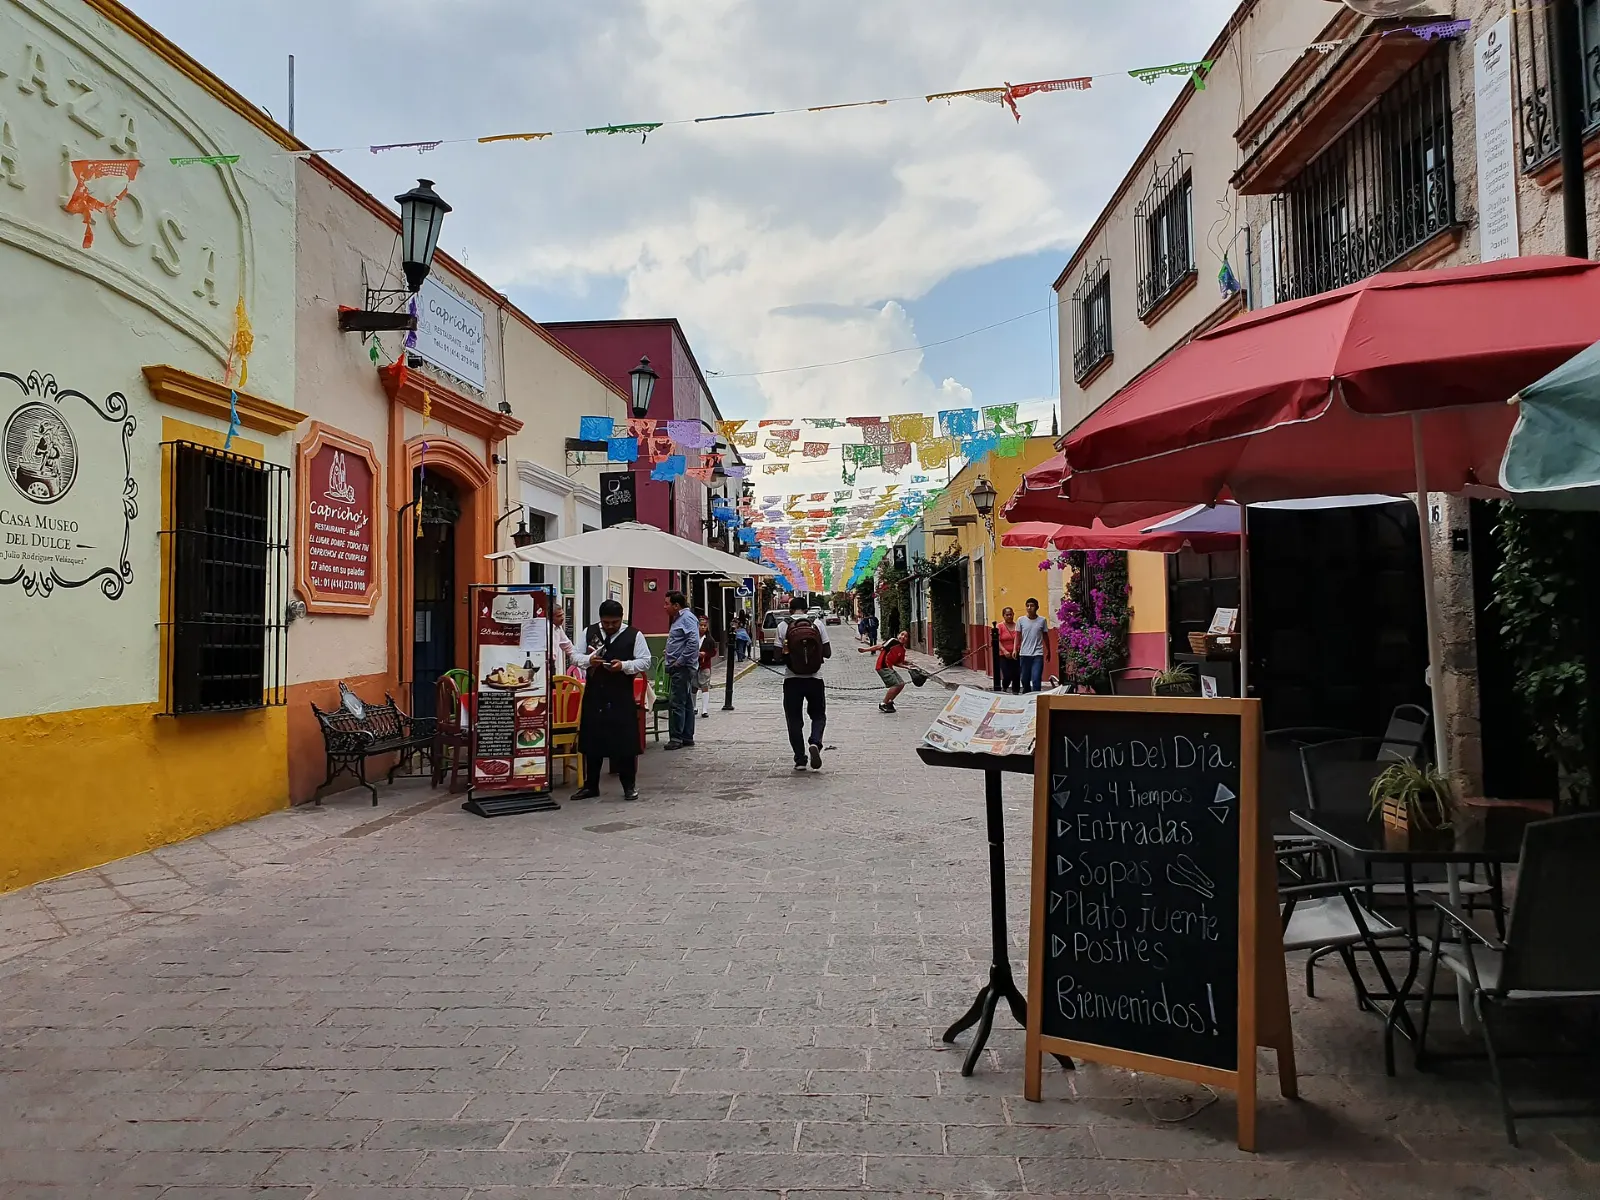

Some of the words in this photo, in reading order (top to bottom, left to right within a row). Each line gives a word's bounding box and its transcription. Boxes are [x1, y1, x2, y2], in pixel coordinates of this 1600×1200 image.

[0, 45, 146, 167] AZA
[429, 299, 481, 343] Capricho's
[310, 501, 369, 525] Capricho's
[1431, 505, 1440, 522] 16
[6, 532, 28, 546] DEL
[314, 522, 346, 535] RESTAURANTE
[349, 529, 360, 537] BAR
[4, 550, 20, 560] Julio
[311, 560, 318, 571] 27
[318, 562, 332, 572] años
[332, 565, 340, 573] en
[339, 566, 347, 574] su
[346, 566, 366, 577] paladar
[323, 578, 330, 587] 01
[330, 579, 344, 590] (414)
[344, 580, 354, 589] 273
[1130, 738, 1167, 769] Del
[1128, 781, 1193, 811] tiempos
[1077, 812, 1193, 845] Entradas
[1079, 852, 1152, 898] Sopas
[1064, 890, 1127, 931] Plato
